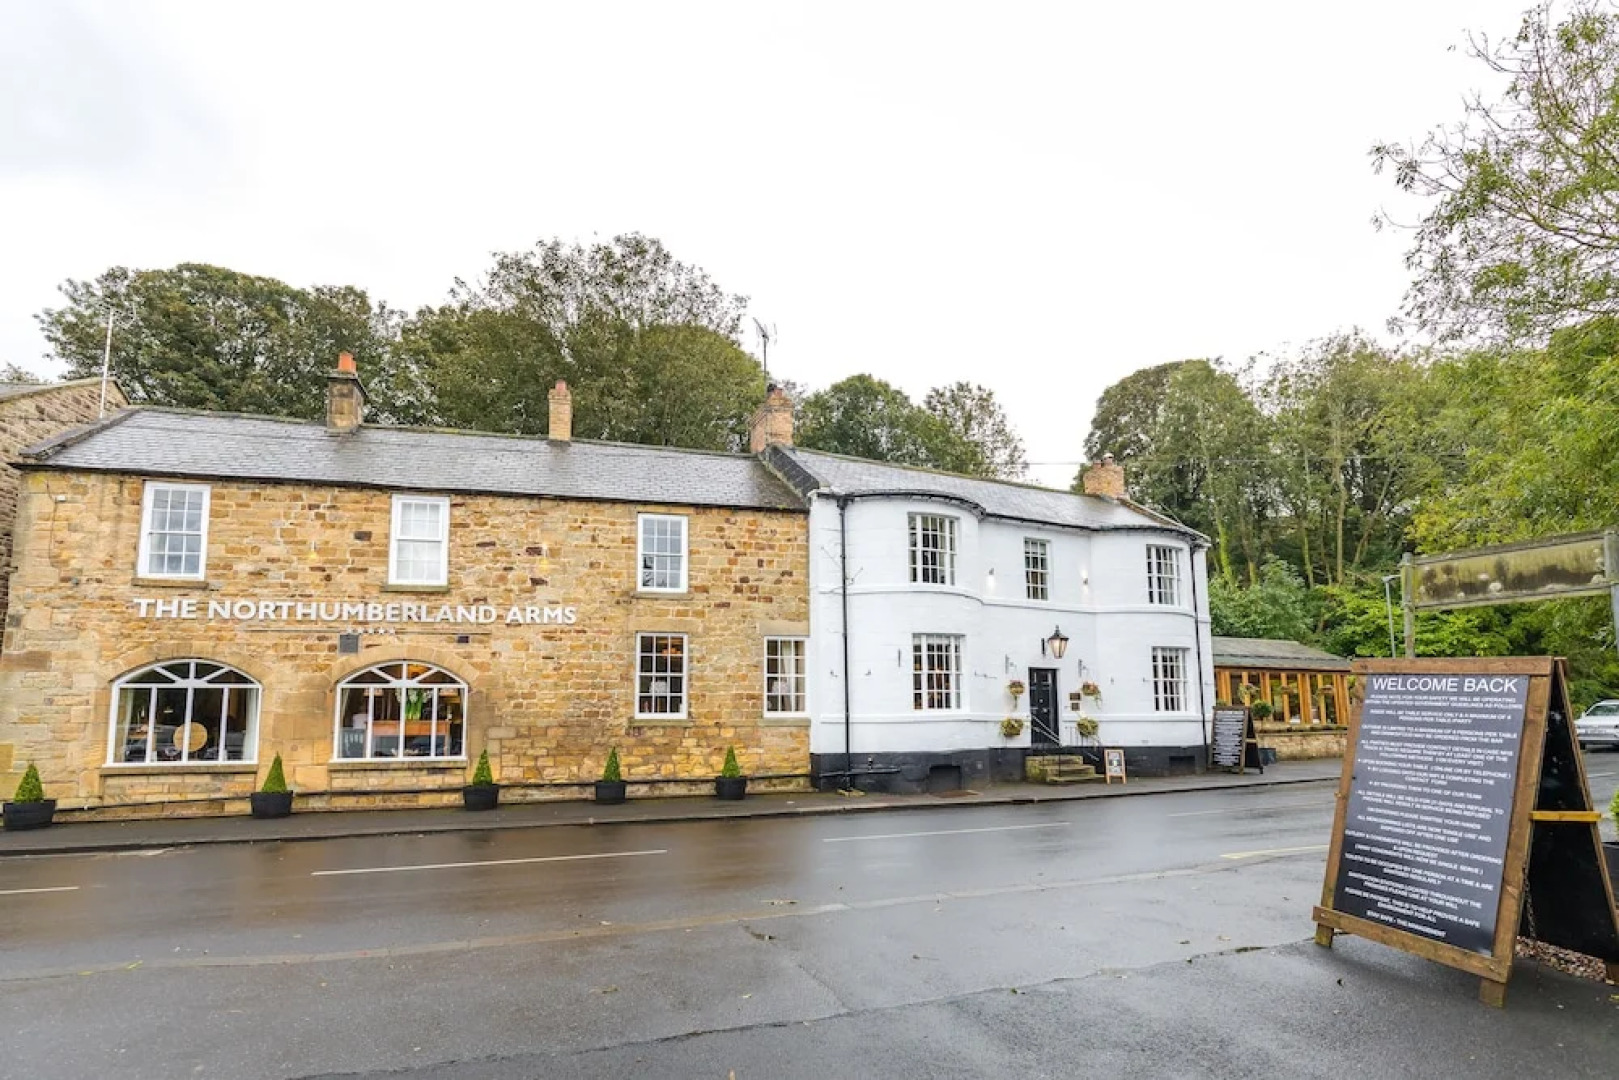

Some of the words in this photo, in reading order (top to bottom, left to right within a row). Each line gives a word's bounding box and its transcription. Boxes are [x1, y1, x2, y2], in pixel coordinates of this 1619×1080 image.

[133, 597, 198, 620] THE
[207, 600, 497, 624] NORTHUMBERLAND
[504, 604, 577, 625] ARMS
[1372, 677, 1458, 692] WELCOME
[1464, 678, 1518, 693] BACK
